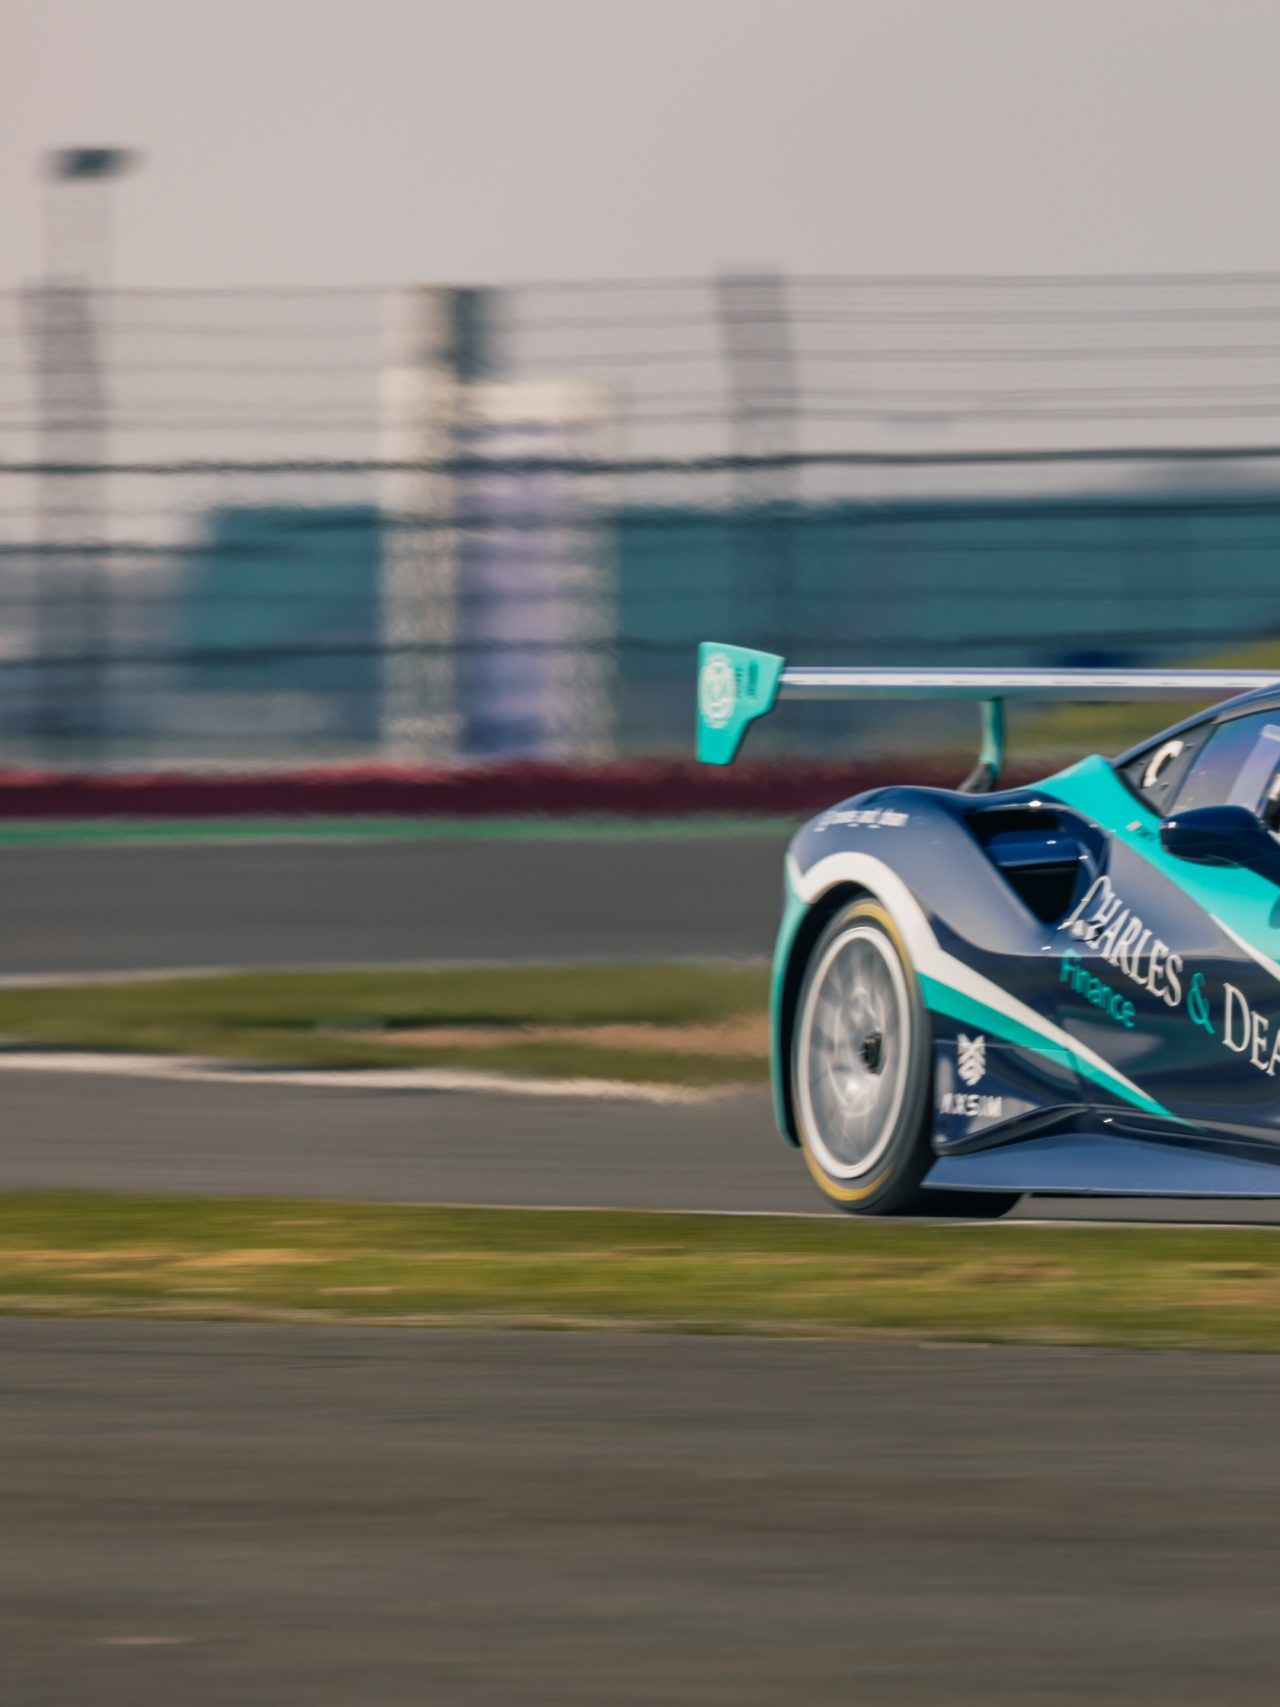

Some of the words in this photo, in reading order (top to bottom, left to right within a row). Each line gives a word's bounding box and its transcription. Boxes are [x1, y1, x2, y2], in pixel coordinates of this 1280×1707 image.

[1059, 948, 1136, 1029] Finance
[1068, 876, 1183, 1007] CHARLES
[1187, 972, 1215, 1034] &
